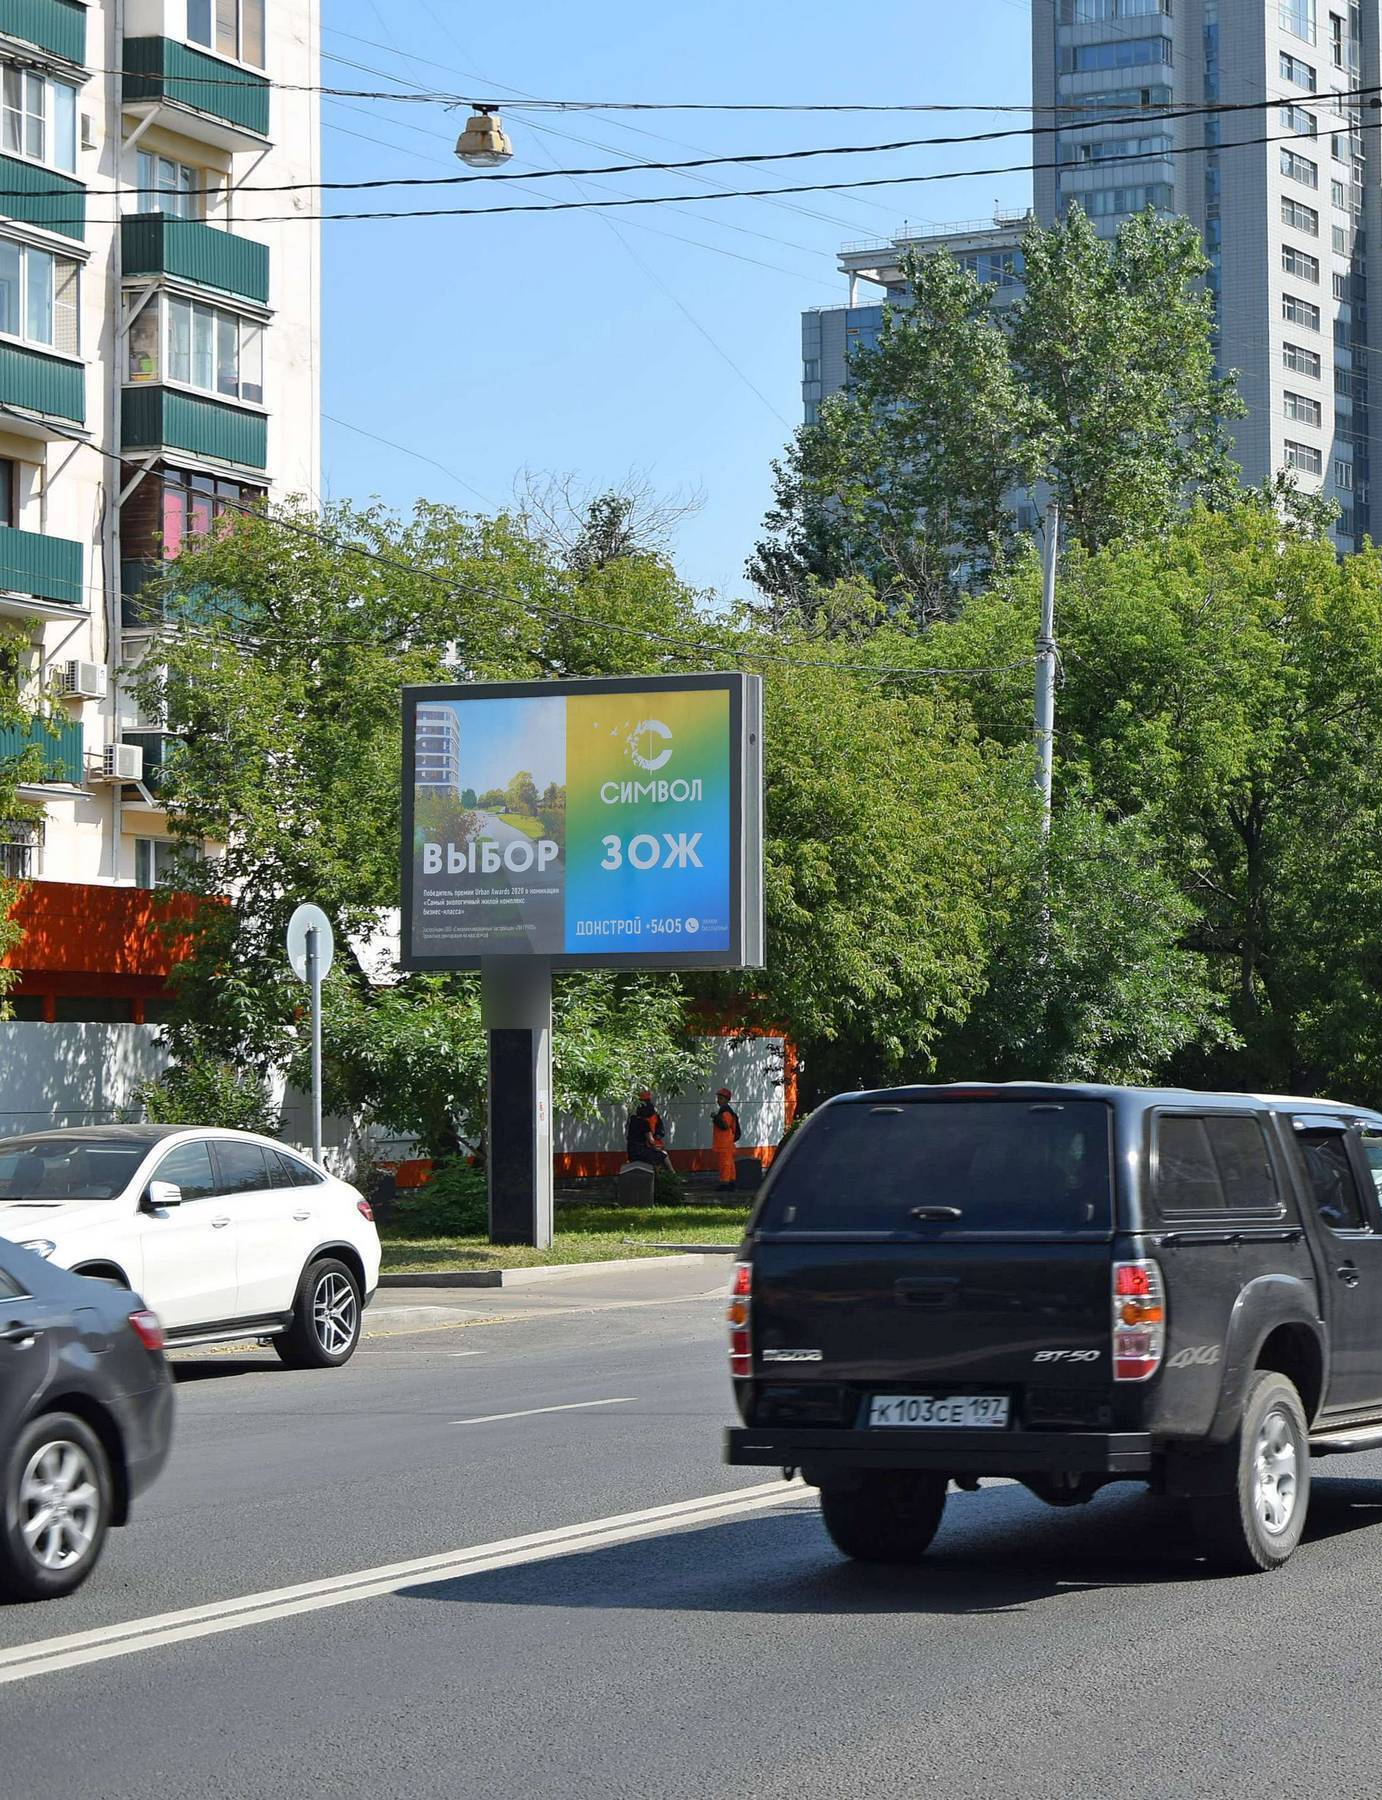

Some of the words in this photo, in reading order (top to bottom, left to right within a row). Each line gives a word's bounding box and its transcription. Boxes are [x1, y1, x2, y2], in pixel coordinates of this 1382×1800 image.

[600, 778, 703, 805] СИМВОЛ
[423, 840, 559, 875] ВЫБОР
[600, 833, 705, 871] ЗОЖ
[475, 888, 490, 896] Urban
[491, 888, 510, 896] Awards
[576, 917, 641, 936] ДОНСТРОЙ
[1033, 1350, 1101, 1363] BT-50
[968, 1398, 1003, 1417] 197
